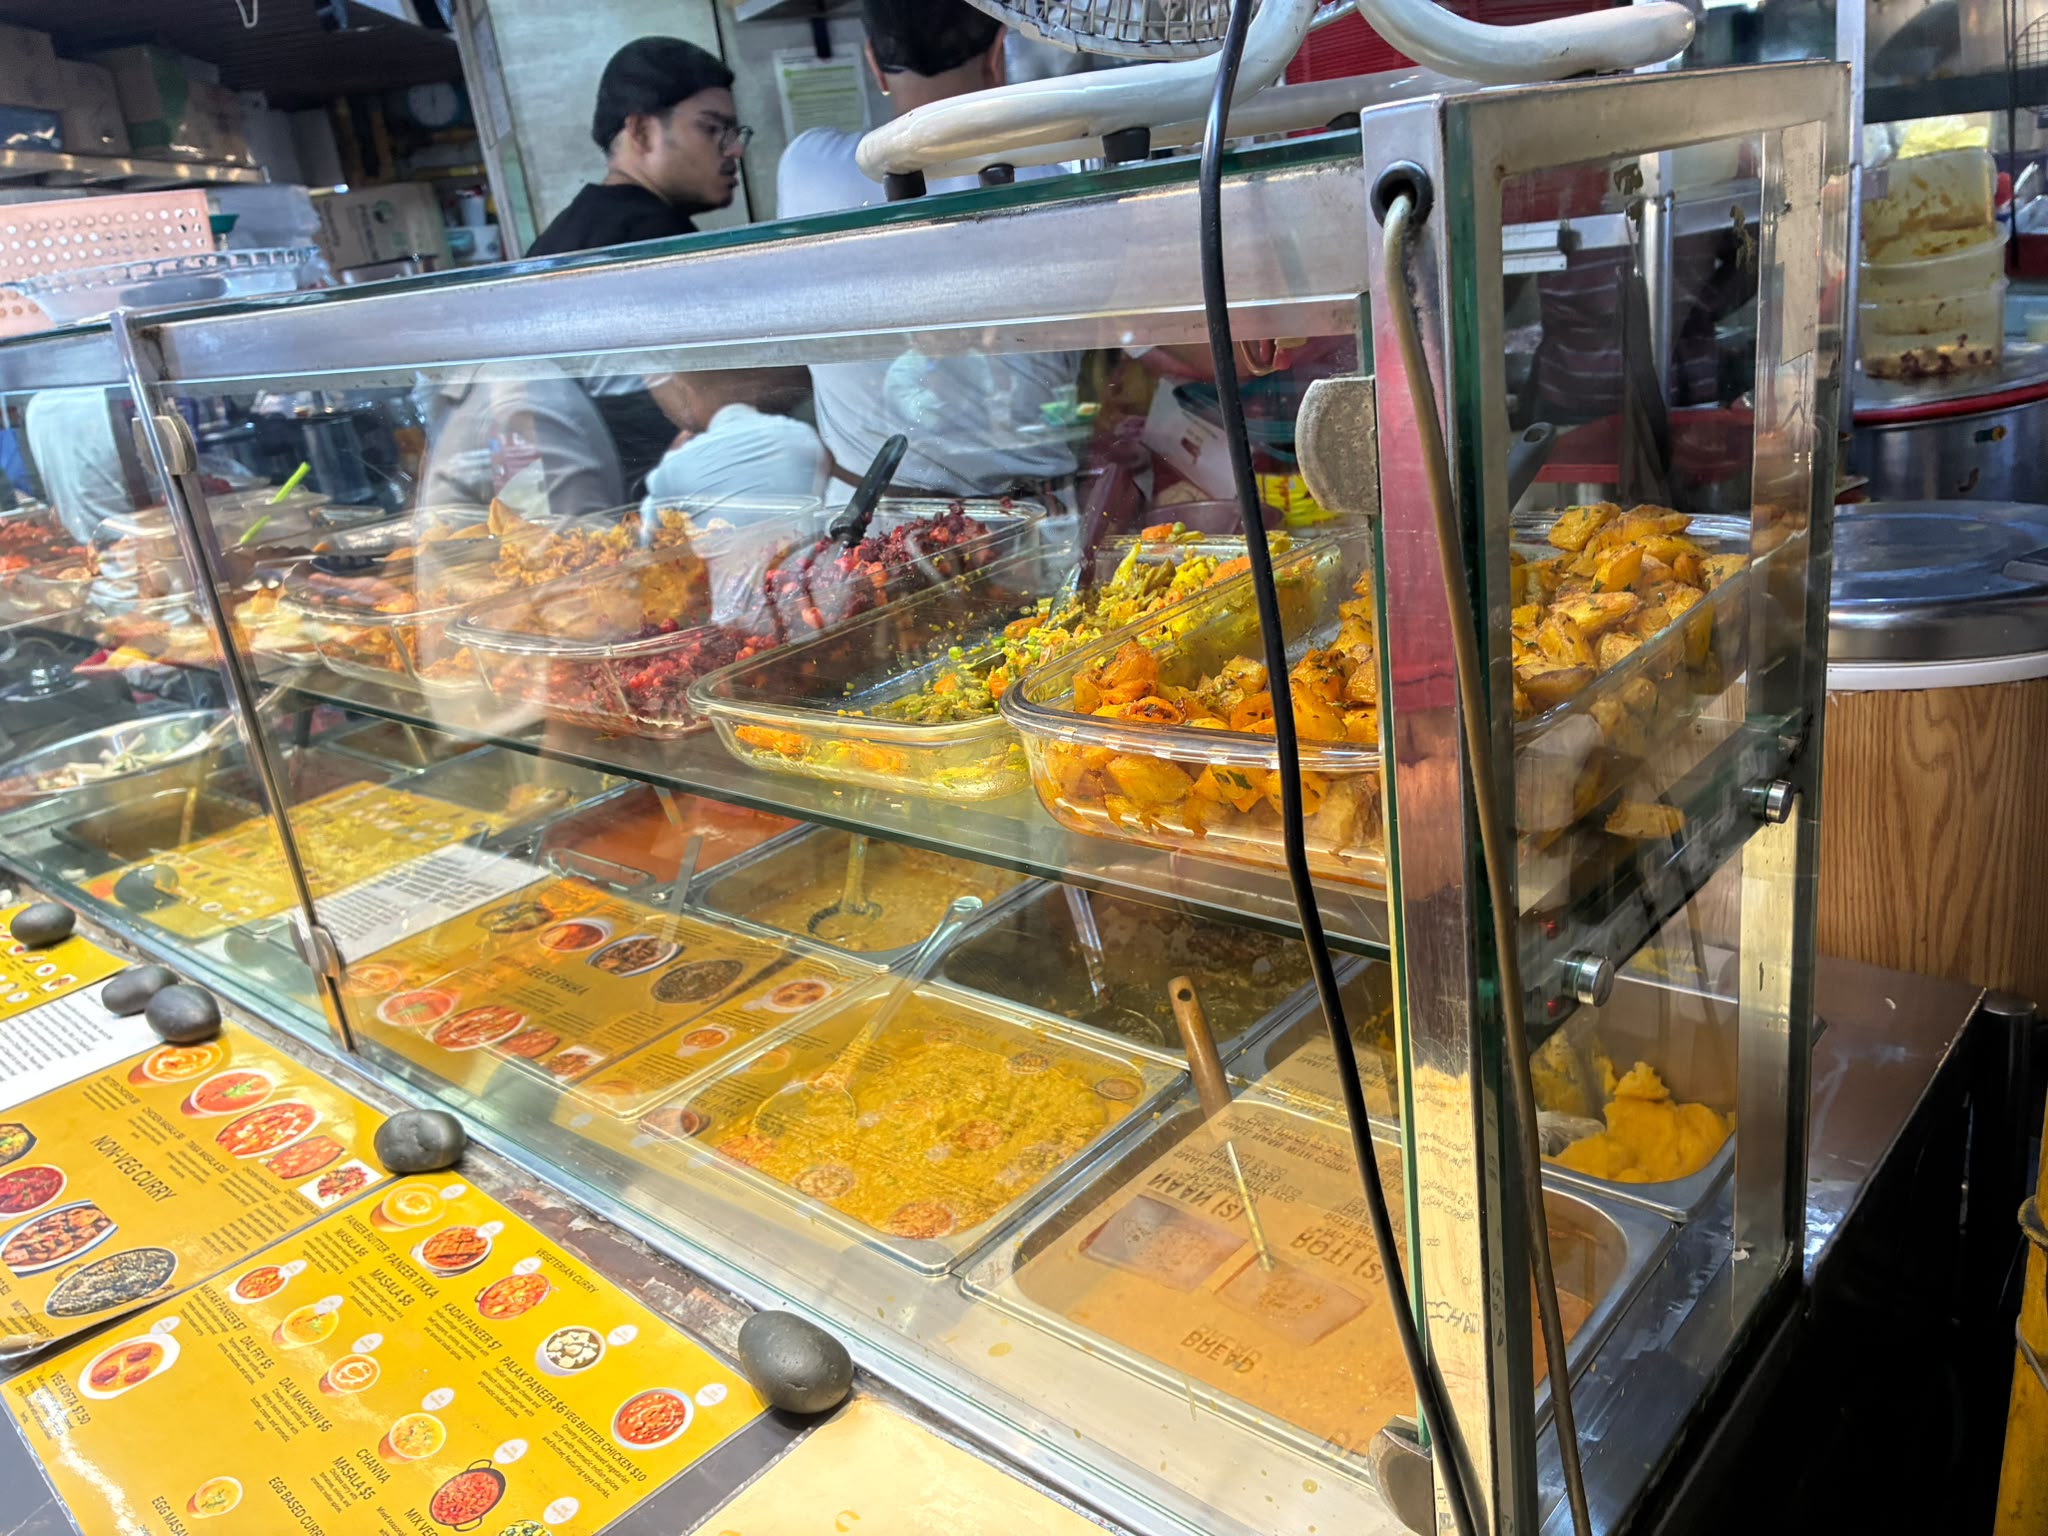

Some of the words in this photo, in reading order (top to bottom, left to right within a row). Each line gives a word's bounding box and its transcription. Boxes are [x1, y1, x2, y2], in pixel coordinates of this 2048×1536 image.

[89, 1134, 144, 1175] NON-VEG
[128, 1168, 177, 1204] CURRY
[368, 1268, 406, 1297] MASALA
[383, 1252, 420, 1280] PANEER
[410, 1276, 441, 1298] TIKKA
[198, 1283, 221, 1304] MATAR
[214, 1301, 240, 1324] PANEER
[441, 1302, 468, 1322] KADAI
[461, 1319, 493, 1344] PANEER
[239, 1335, 257, 1350] DAL
[249, 1347, 267, 1361] FRY
[49, 1371, 66, 1386] VEG
[57, 1384, 79, 1407] KOFTA
[499, 1356, 529, 1380] PALAK
[521, 1376, 557, 1405] PANEER
[550, 1400, 568, 1414] $6
[277, 1376, 298, 1393] DAL
[289, 1390, 324, 1423] MAKHANI
[315, 1419, 333, 1433] $6
[354, 1447, 392, 1484] CHANNA
[562, 1409, 580, 1423] VEG
[575, 1420, 605, 1445] BUTTER
[599, 1442, 634, 1470] CHICKEN
[628, 1467, 648, 1482] $10
[267, 1476, 288, 1494] EGG
[280, 1491, 307, 1518] BASED
[331, 1455, 367, 1490] MASALA
[357, 1485, 377, 1501] $5
[151, 1495, 171, 1515] EGG
[403, 1507, 425, 1526] MIX
